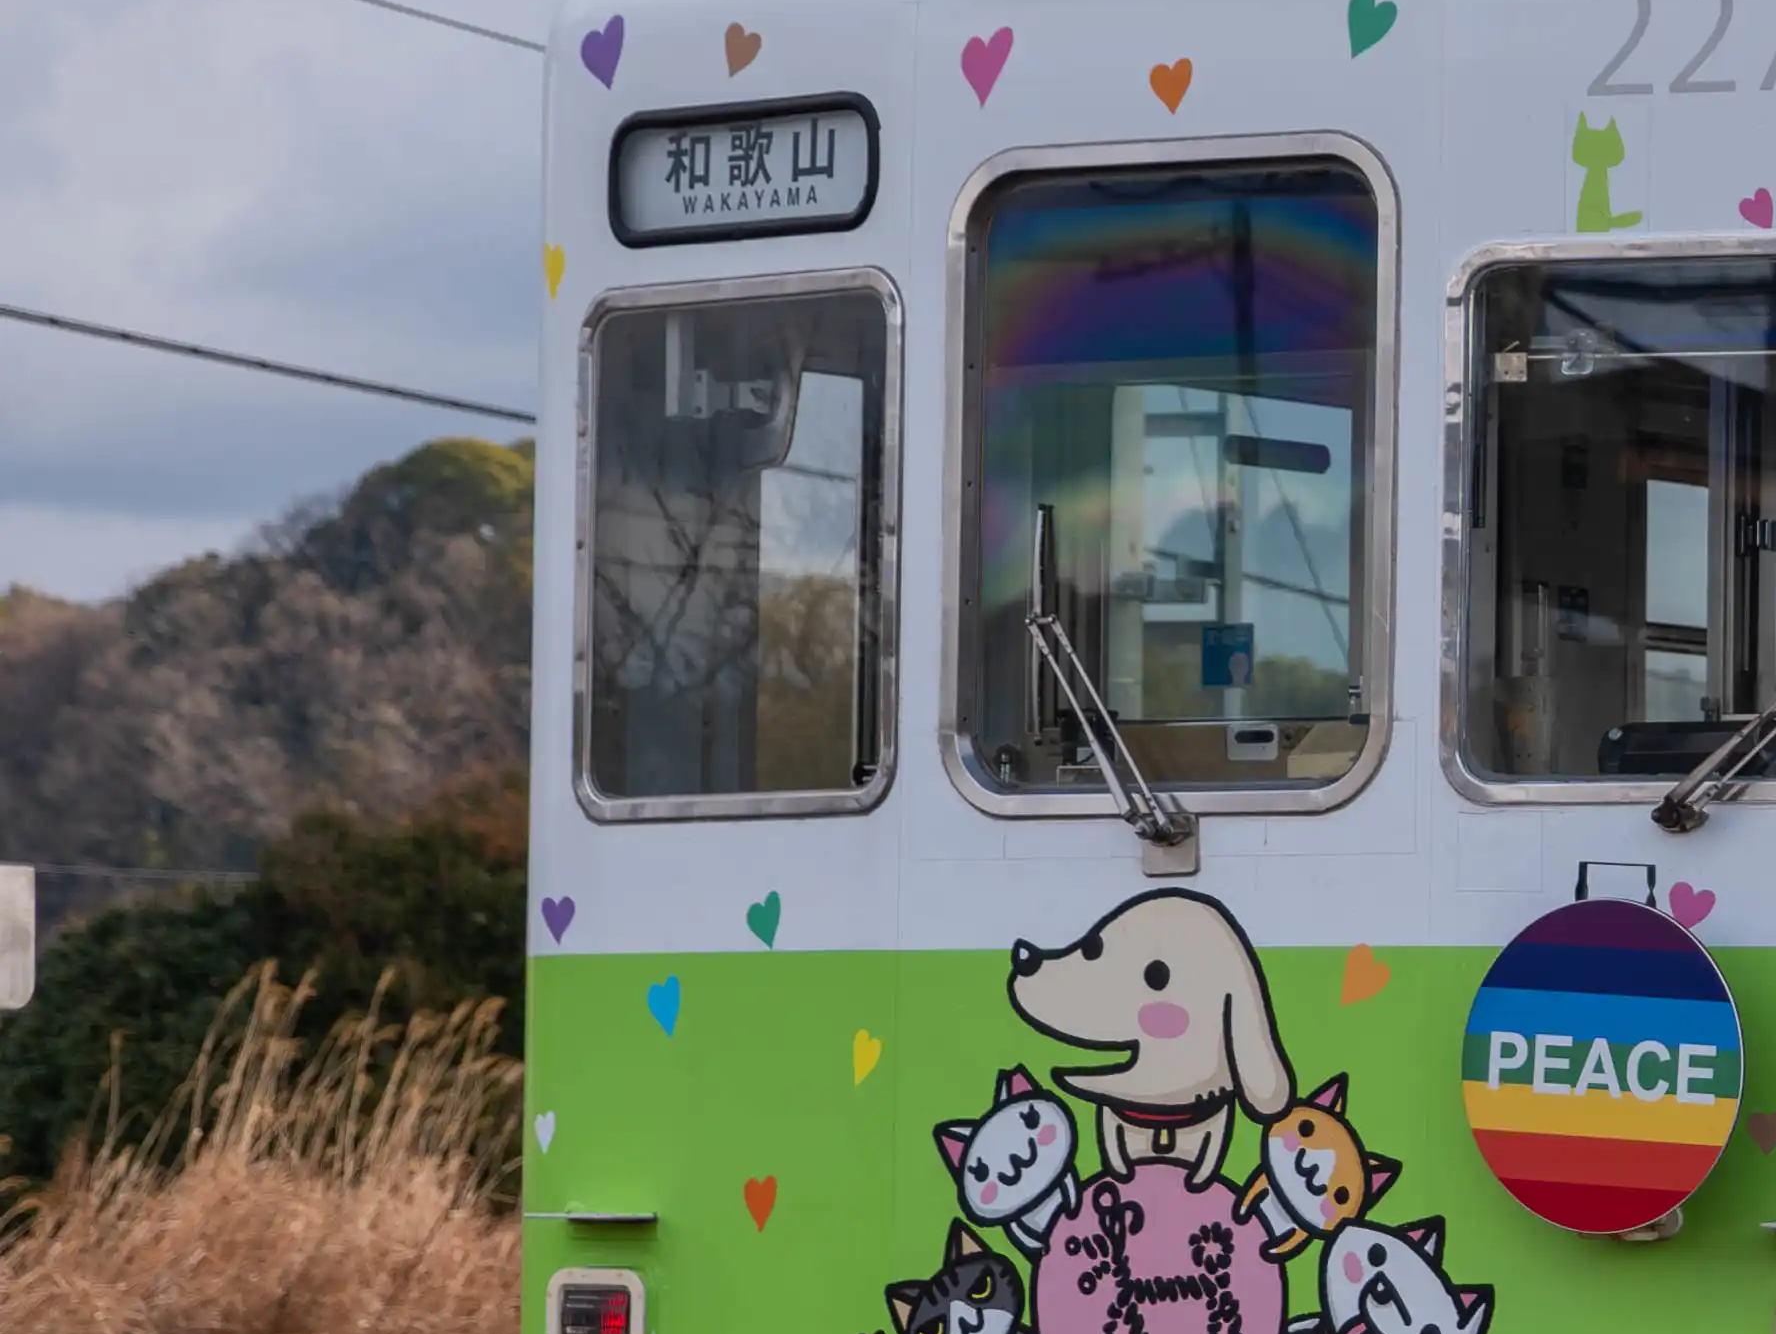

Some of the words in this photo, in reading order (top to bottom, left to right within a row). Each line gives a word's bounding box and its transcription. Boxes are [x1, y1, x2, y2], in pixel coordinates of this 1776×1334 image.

[664, 117, 837, 194] 和歌山
[682, 185, 818, 215] WAKAYAMA
[1487, 1031, 1717, 1106] PEACE
